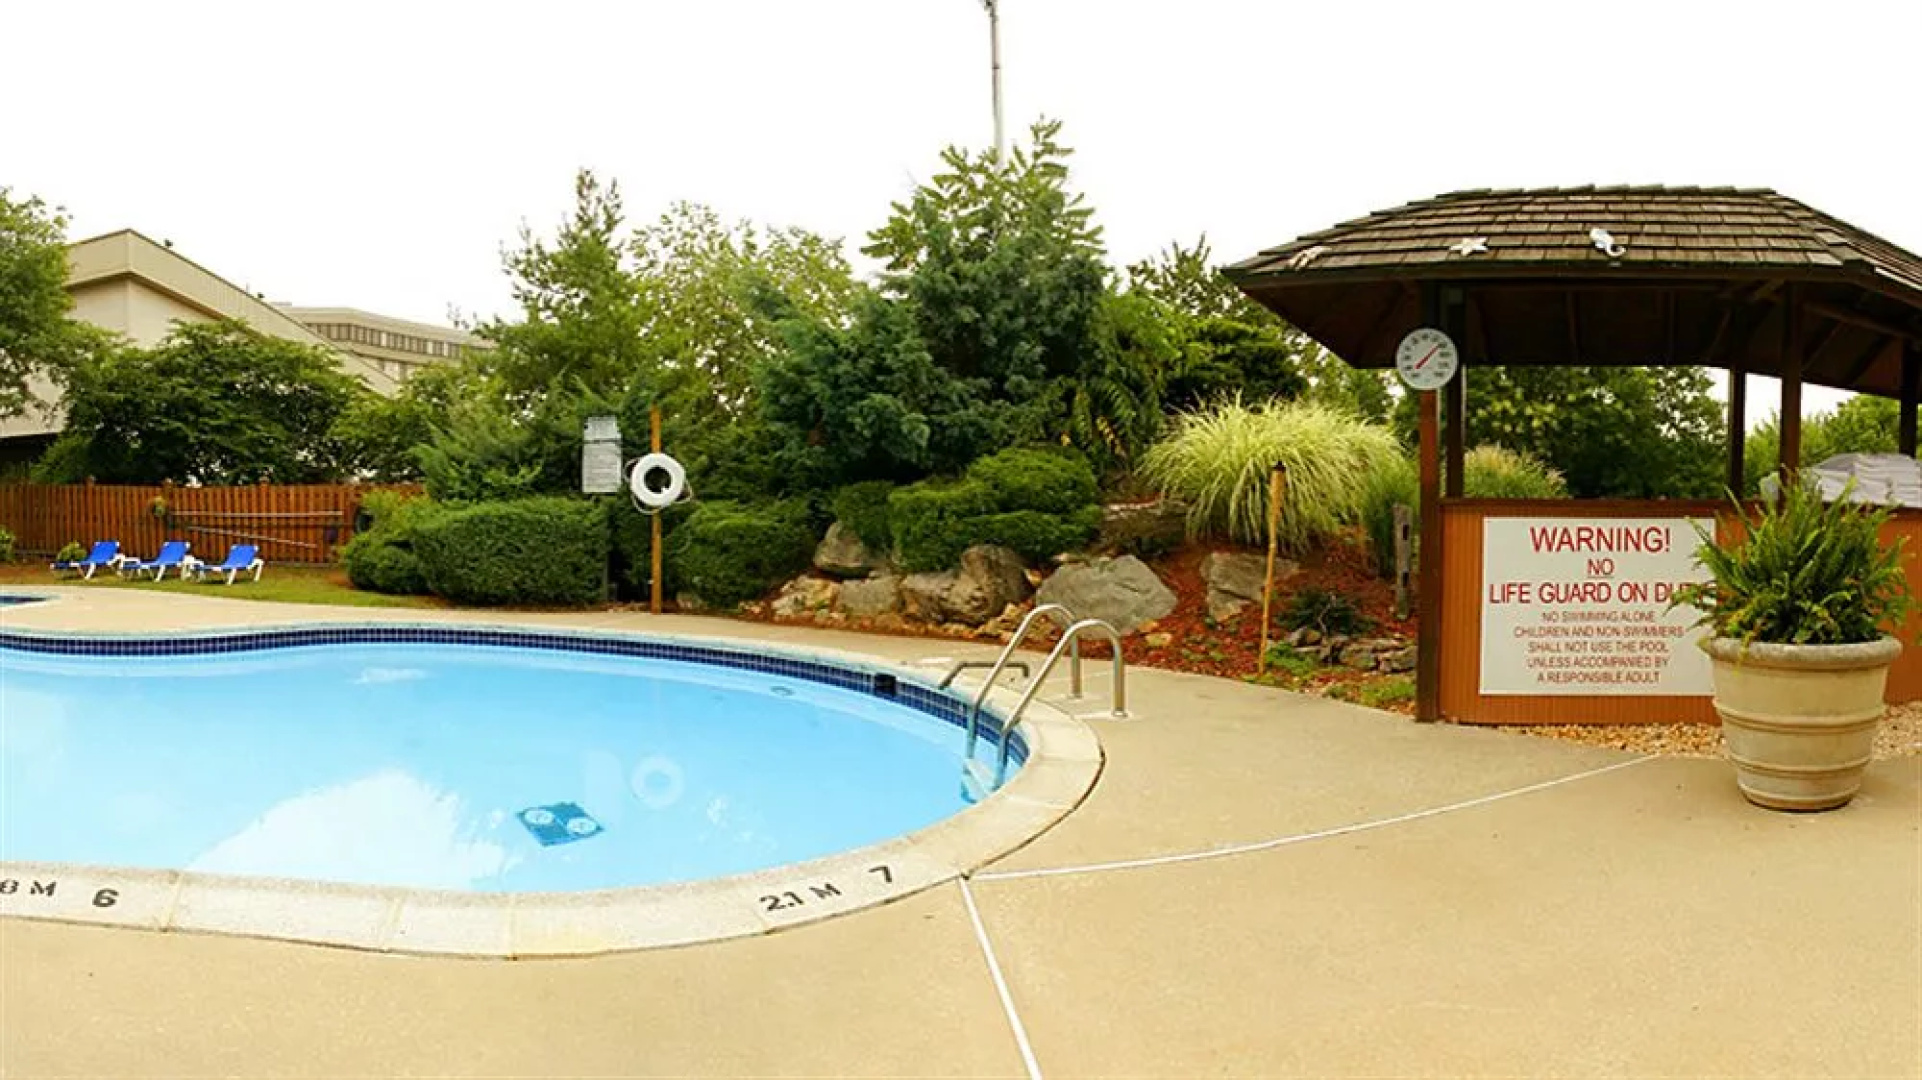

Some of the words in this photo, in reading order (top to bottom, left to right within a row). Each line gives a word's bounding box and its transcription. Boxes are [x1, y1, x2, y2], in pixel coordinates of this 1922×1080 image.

[1529, 526, 1670, 553] WARNING!
[1587, 558, 1615, 576] NO
[1489, 583, 1531, 604] LIFE
[1538, 582, 1612, 604] GUARD
[1617, 582, 1648, 604] ON
[1542, 611, 1559, 623] NO
[1562, 611, 1618, 623] SWIMMING
[1621, 611, 1656, 623] ALONE
[1514, 626, 1569, 638] CHILDREN
[1571, 626, 1594, 638] AND
[1528, 641, 1561, 653] SHALL
[1564, 641, 1588, 653] NOT
[1590, 641, 1613, 653] USE
[1616, 641, 1637, 653] THE
[1639, 641, 1669, 653] POOL
[1527, 656, 1571, 668] UNLESS
[1573, 656, 1652, 668] ACCOMPANIED
[1654, 656, 1670, 668] BY
[1547, 671, 1623, 684] RESPONSIBLE
[1625, 671, 1660, 684] ADULT
[30, 880, 57, 897] M
[92, 888, 119, 908] 6
[760, 891, 804, 911] 2.1
[808, 883, 842, 899] M
[868, 865, 893, 883] 7
